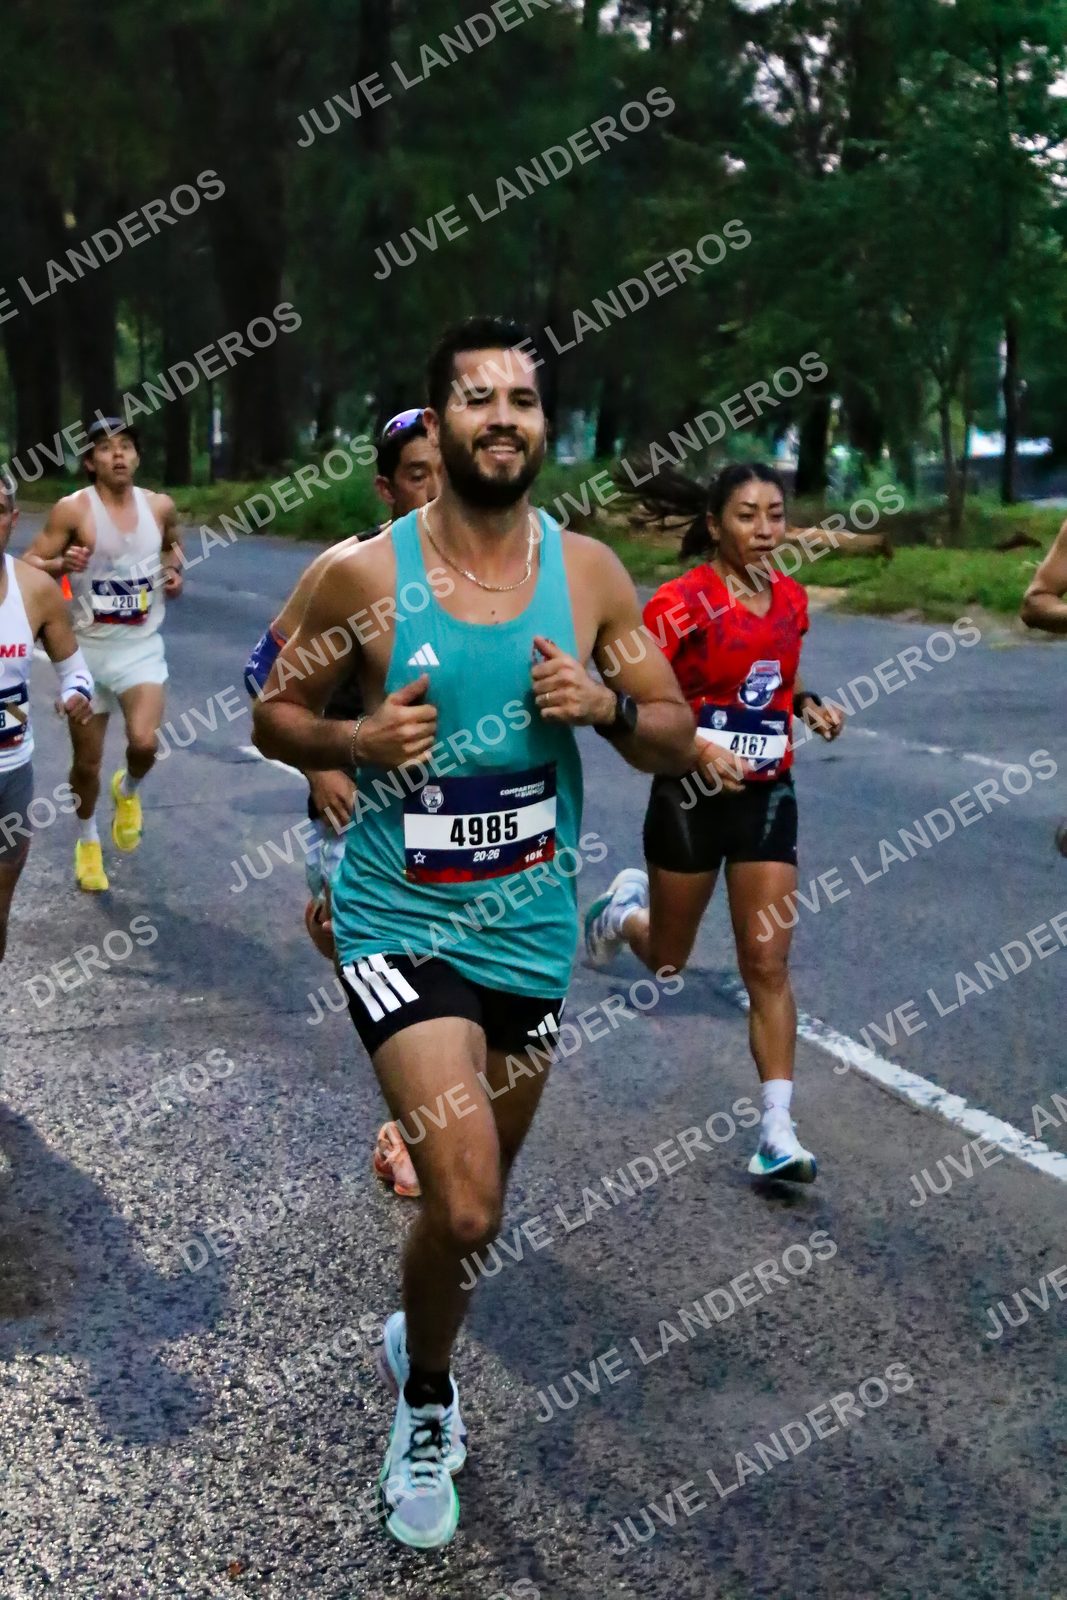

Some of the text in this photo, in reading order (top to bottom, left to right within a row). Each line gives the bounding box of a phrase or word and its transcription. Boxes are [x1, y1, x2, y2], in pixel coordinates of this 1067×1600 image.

[730, 734, 768, 756] 4167
[450, 812, 518, 846] 4985
[473, 849, 500, 862] 20-26
[524, 849, 543, 863] 10K
